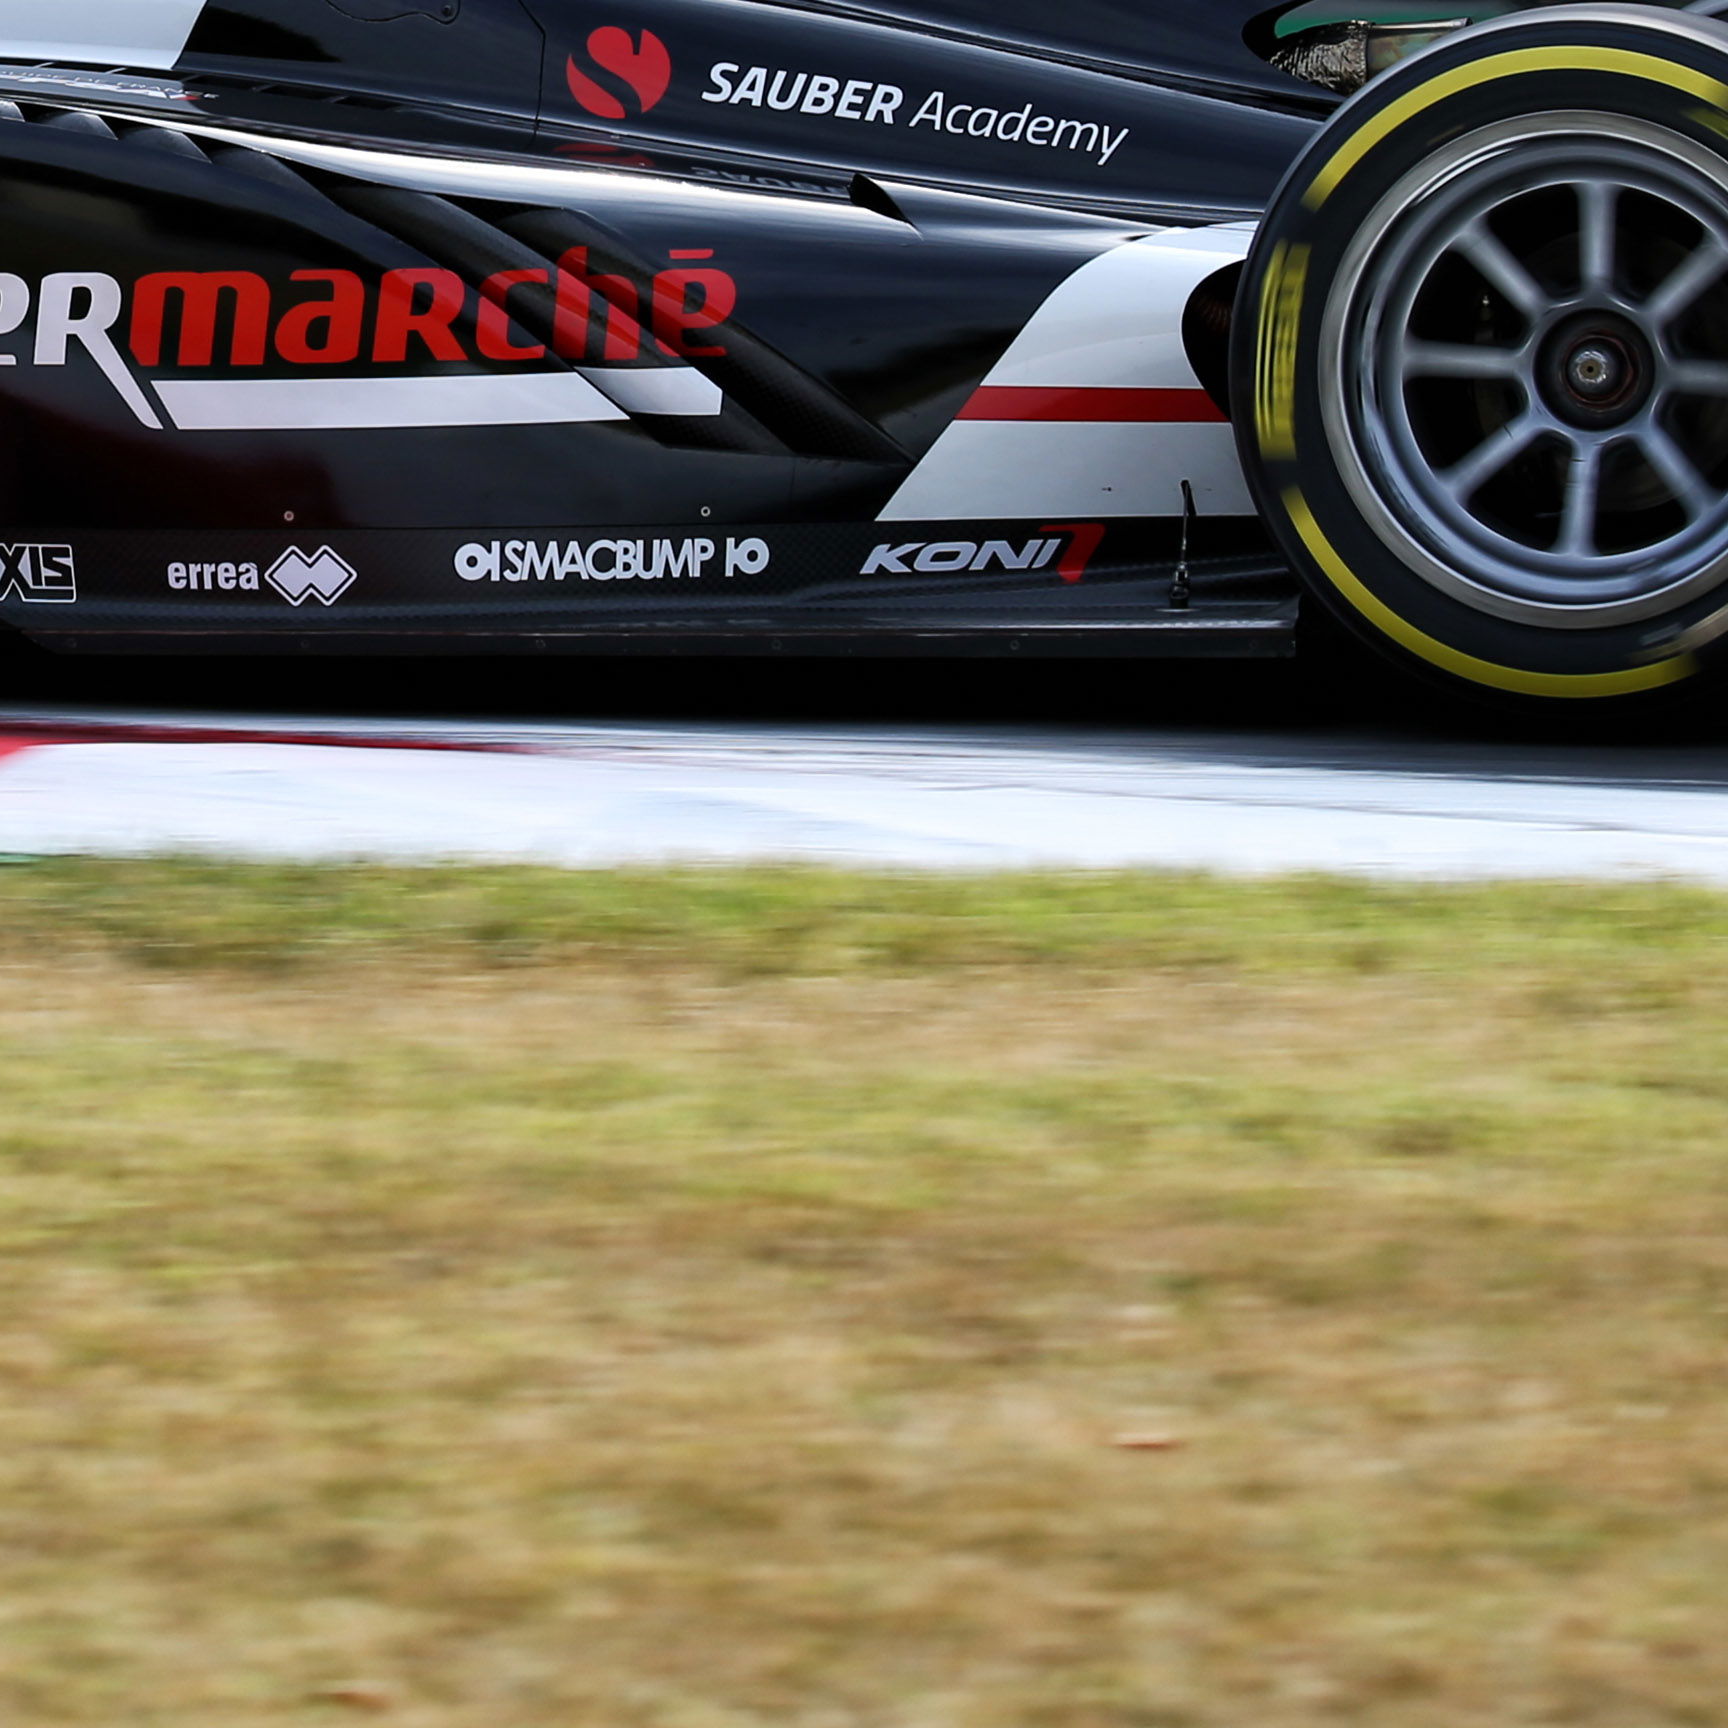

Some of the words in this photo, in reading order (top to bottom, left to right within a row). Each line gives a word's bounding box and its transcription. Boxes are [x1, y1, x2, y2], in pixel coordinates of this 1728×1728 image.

[701, 60, 904, 125] SAUBER
[908, 90, 1130, 166] Academy
[859, 538, 1062, 575] KONI
